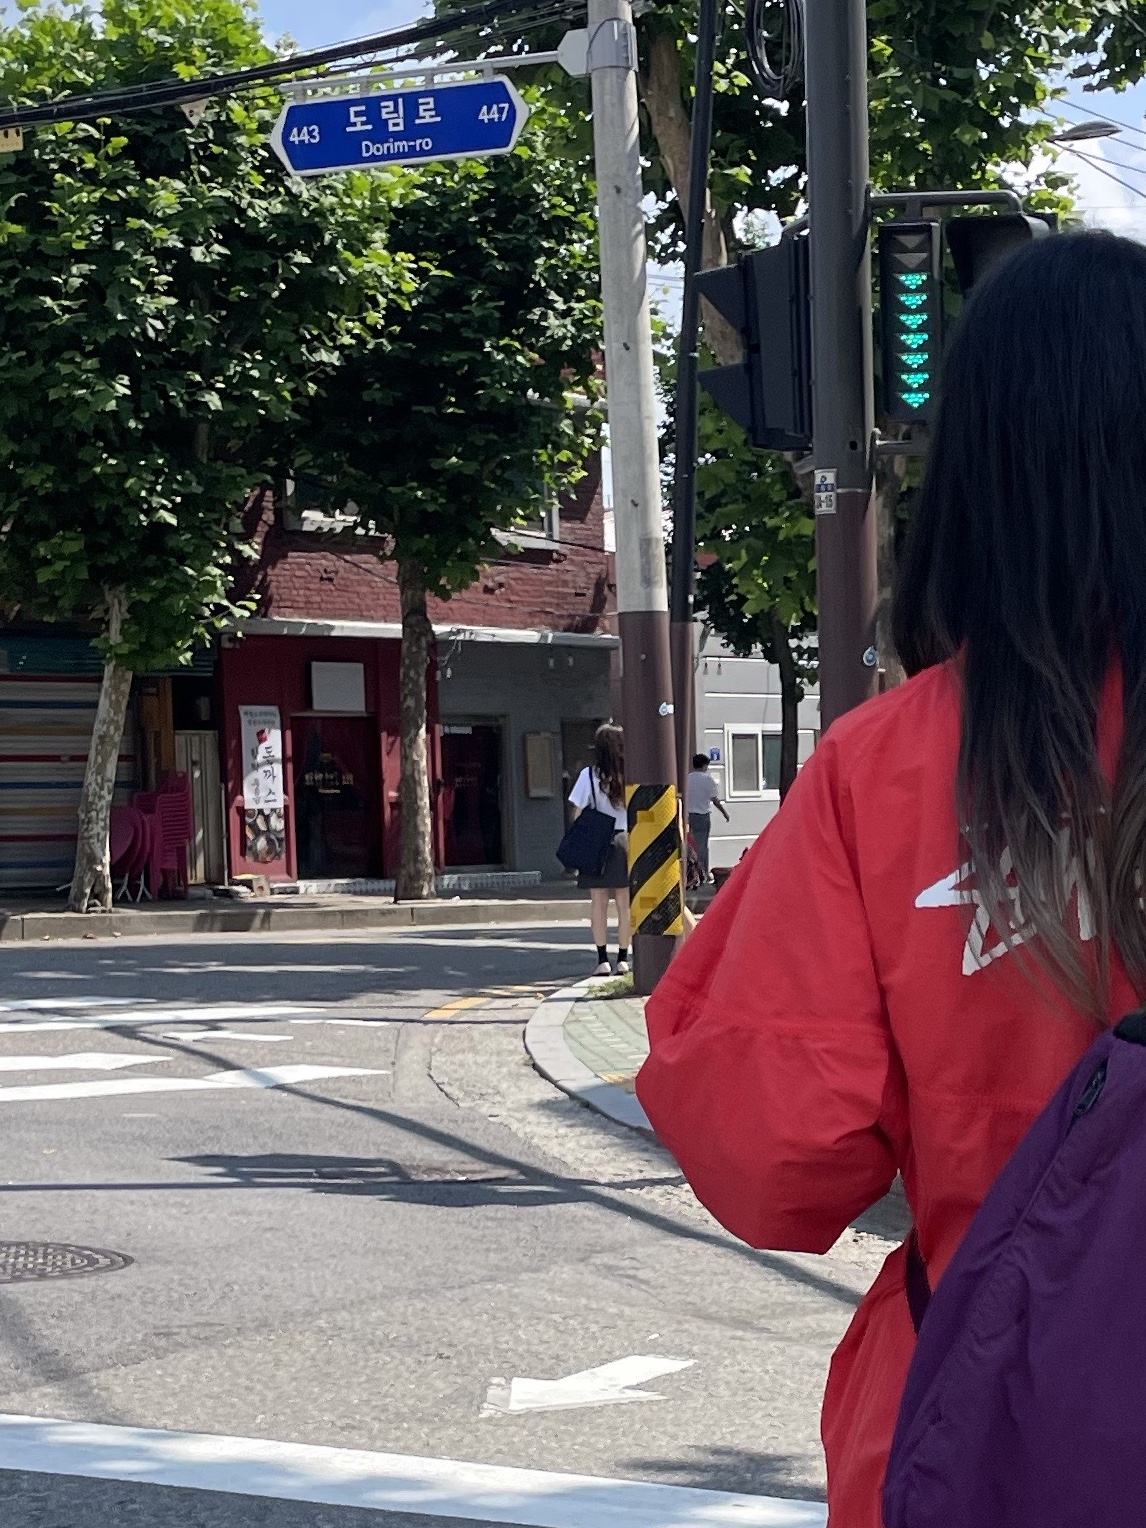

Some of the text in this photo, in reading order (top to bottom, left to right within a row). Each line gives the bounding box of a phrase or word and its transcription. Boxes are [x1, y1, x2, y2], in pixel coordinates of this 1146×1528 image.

[346, 97, 442, 132] 도림로
[478, 103, 510, 123] 447
[289, 125, 320, 144] 443
[361, 136, 433, 157] Dorim-ro
